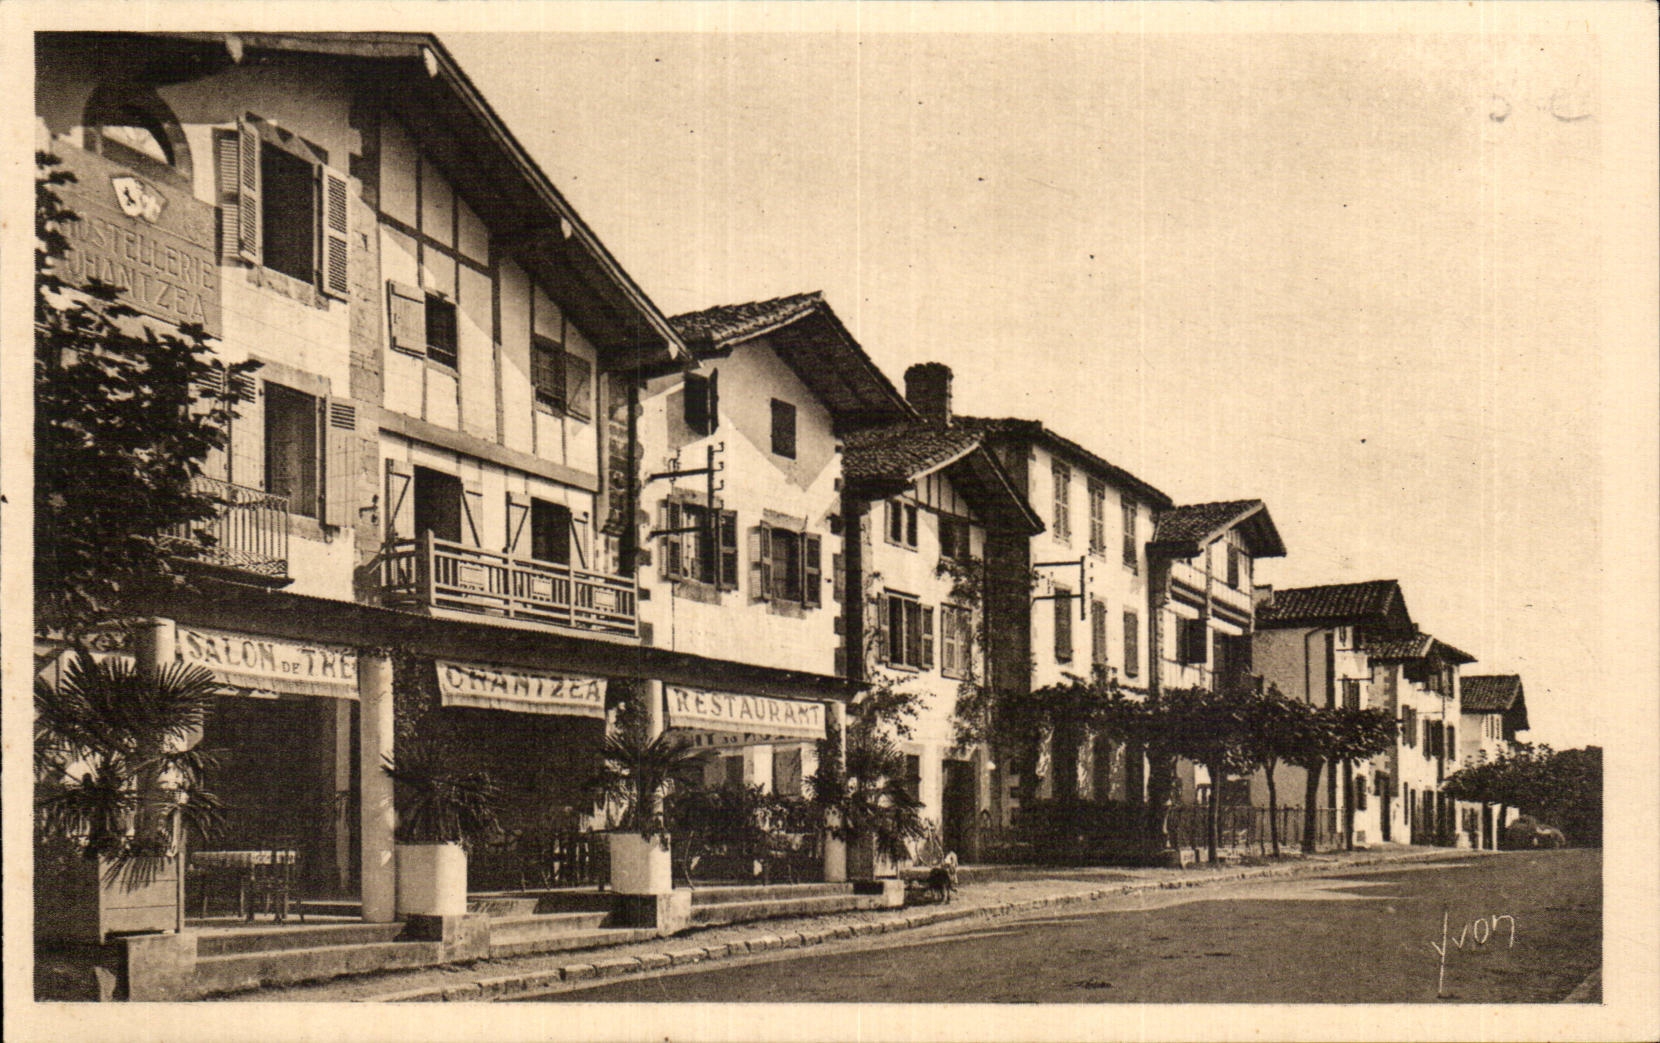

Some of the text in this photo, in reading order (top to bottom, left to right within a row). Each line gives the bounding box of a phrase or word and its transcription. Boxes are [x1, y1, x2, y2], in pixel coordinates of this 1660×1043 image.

[186, 631, 276, 673] SALON
[281, 660, 301, 675] DE
[674, 688, 820, 726] RESTAURANT
